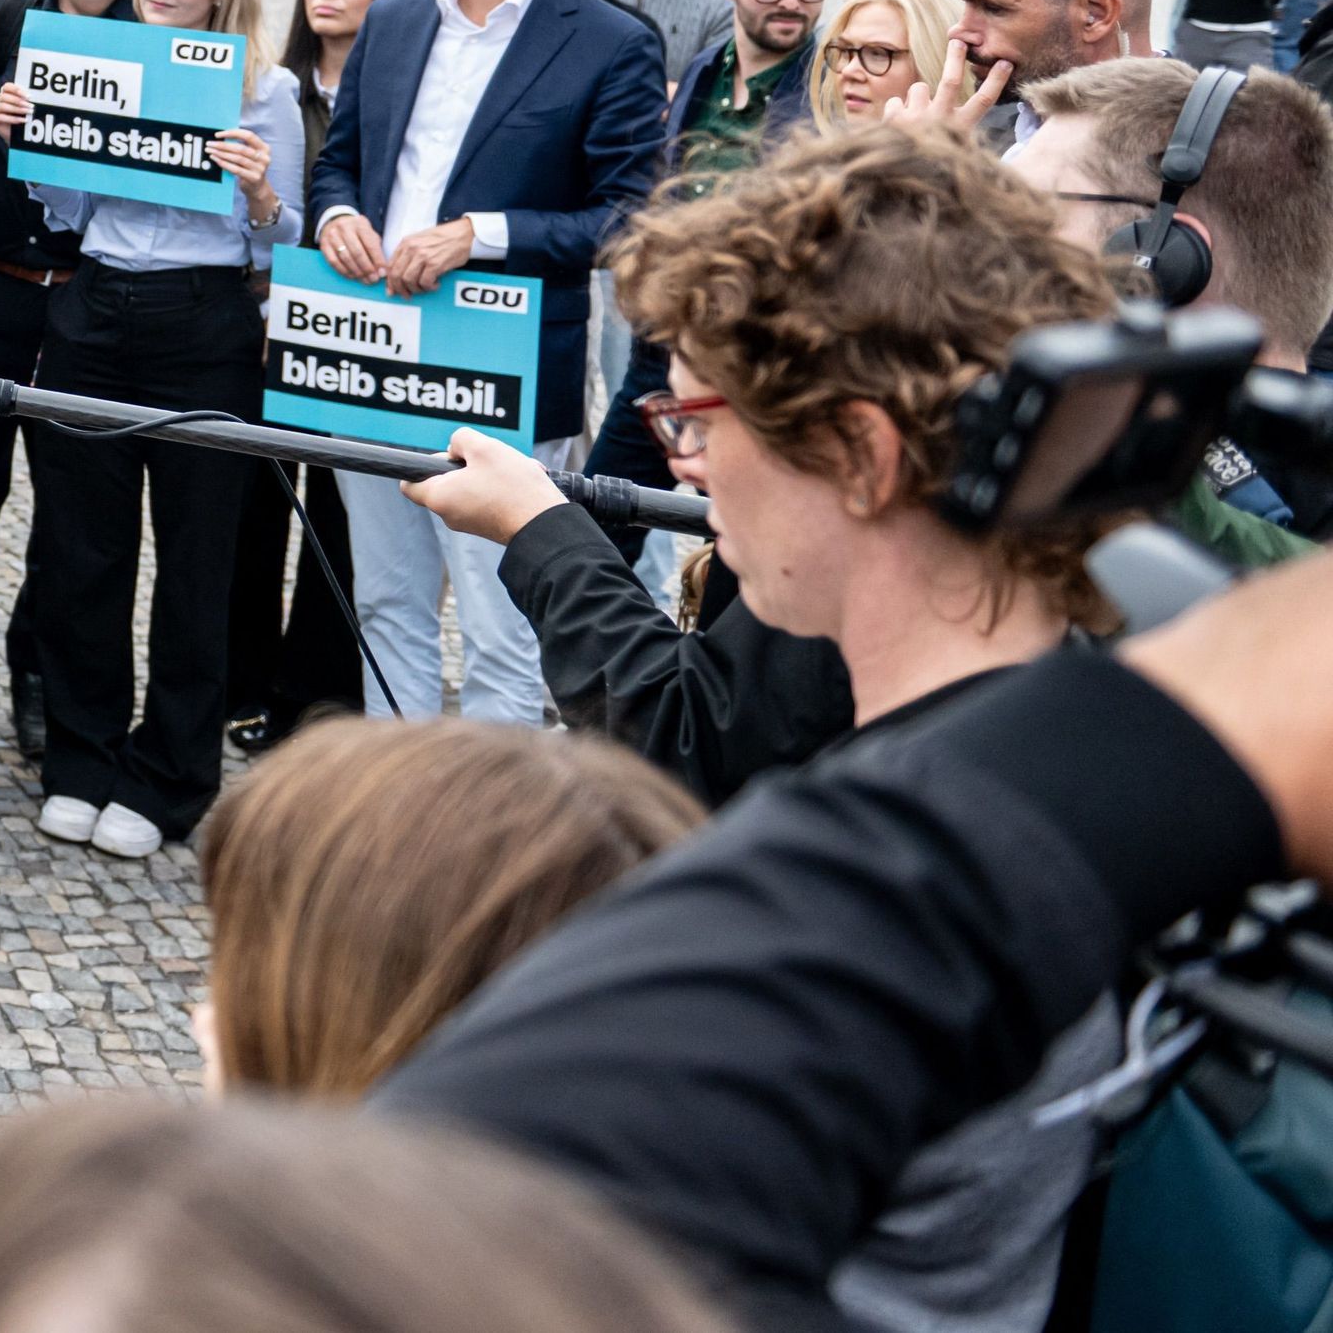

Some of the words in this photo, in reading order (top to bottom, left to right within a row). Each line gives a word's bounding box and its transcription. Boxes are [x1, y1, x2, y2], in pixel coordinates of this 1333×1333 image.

[175, 43, 229, 64] CDU
[28, 62, 127, 108] Berlin,
[23, 112, 104, 153] bleib
[108, 127, 212, 170] stabil.
[460, 286, 524, 308] CDU
[286, 302, 404, 354] Berlin,
[282, 351, 376, 399] bleib
[381, 374, 507, 419] stabil.
